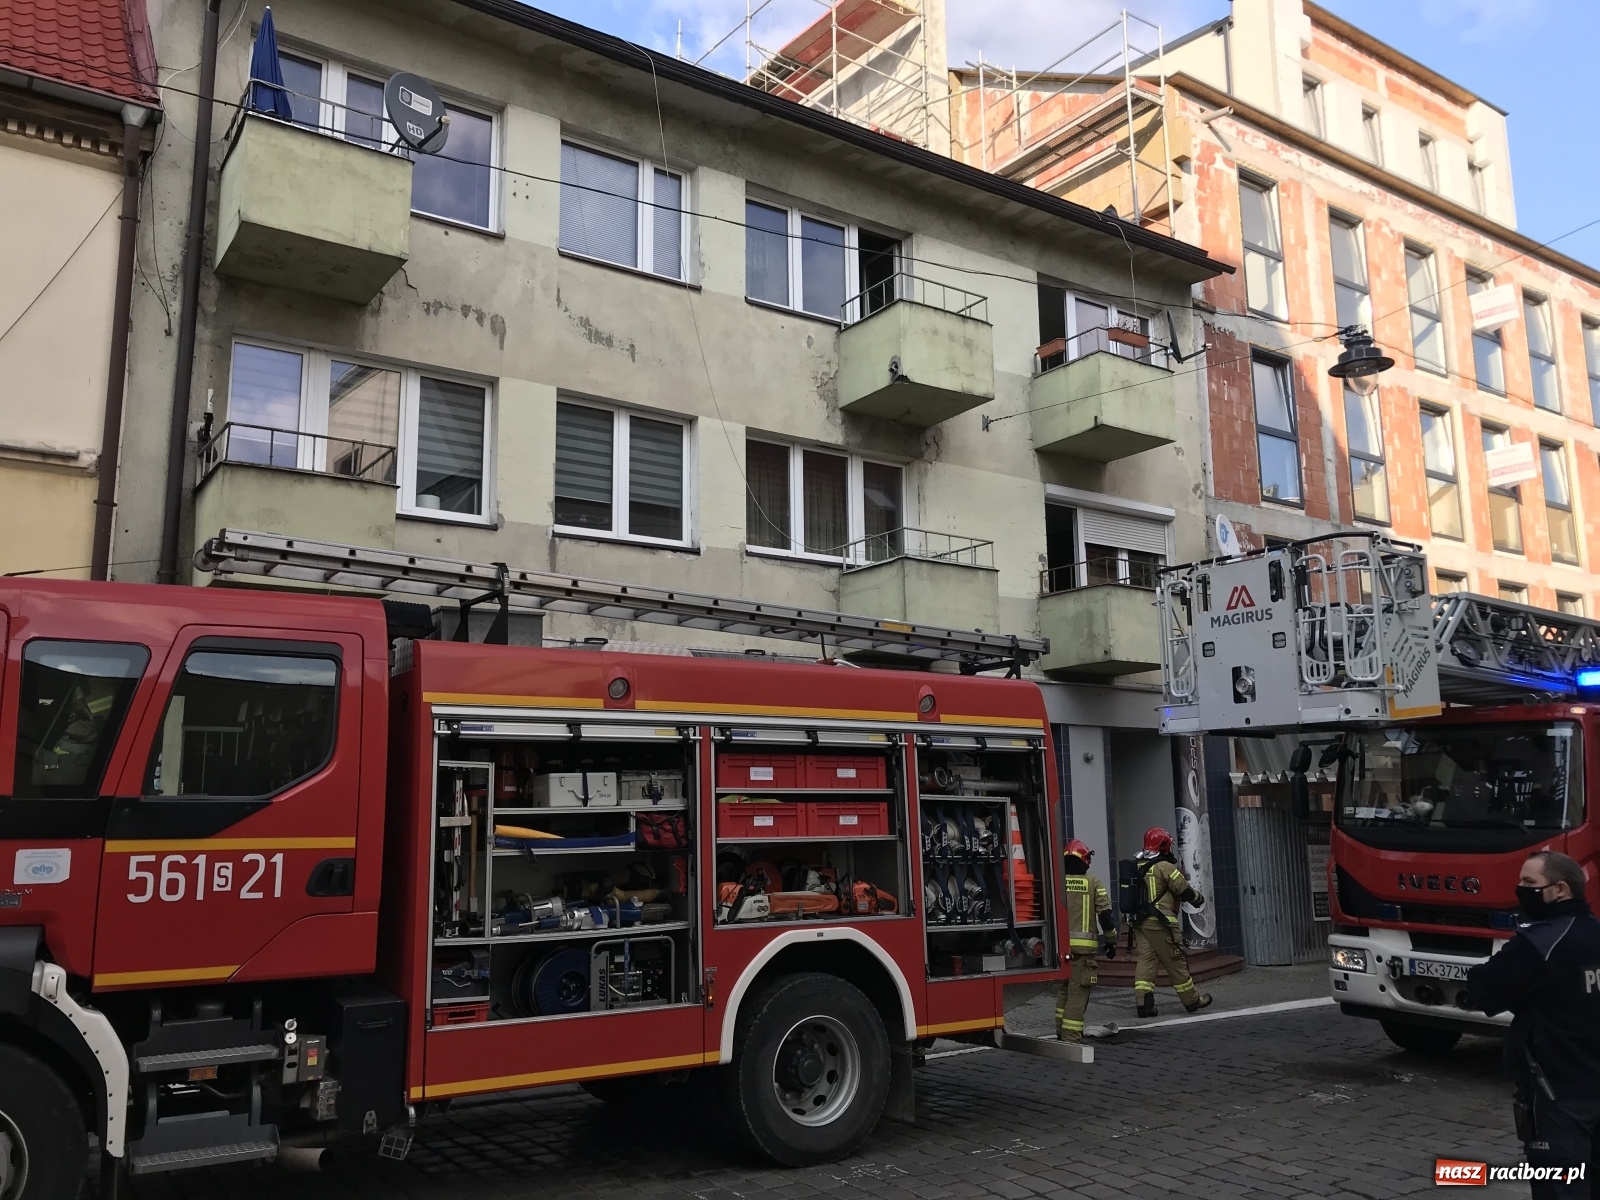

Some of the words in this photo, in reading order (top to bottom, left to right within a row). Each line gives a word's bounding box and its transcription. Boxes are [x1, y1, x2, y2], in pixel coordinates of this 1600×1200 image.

[408, 124, 423, 136] HD
[1210, 608, 1273, 628] MAGIRUS
[1402, 646, 1431, 699] MAGIRUS
[1189, 736, 1198, 770] SPO
[126, 854, 207, 904] 561
[215, 864, 231, 889] S
[239, 853, 284, 899] 21
[1398, 873, 1481, 894] IVECO
[4, 888, 33, 896] DLUM
[1417, 962, 1434, 975] SK
[1439, 964, 1468, 978] 372M
[598, 968, 606, 1002] LUKAS
